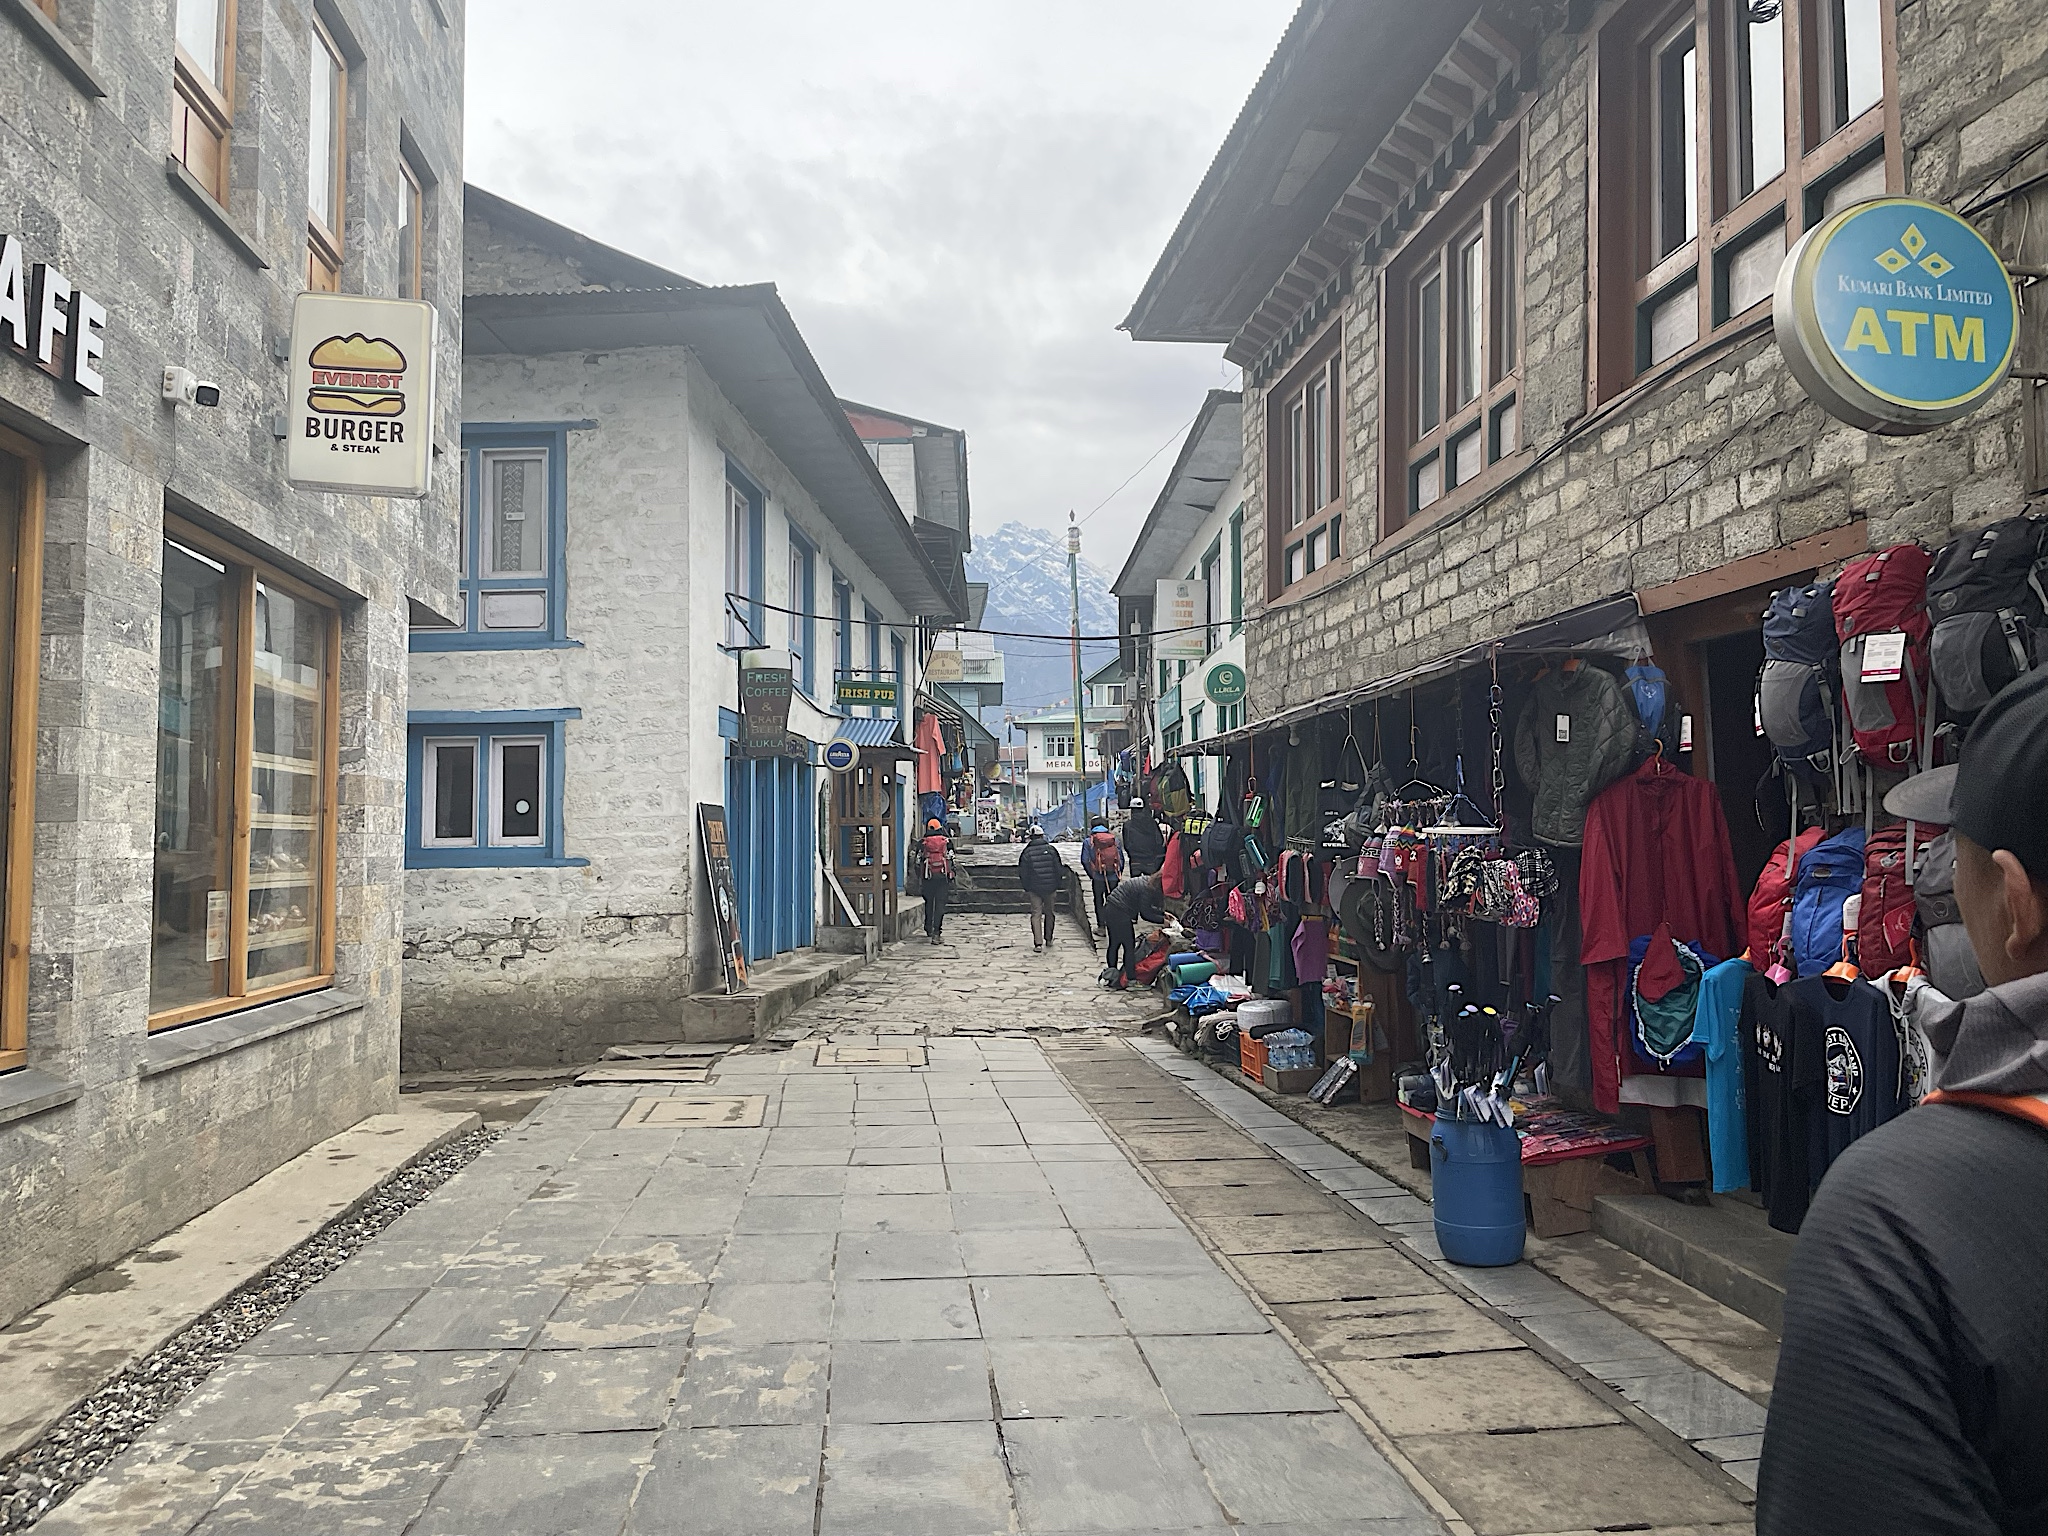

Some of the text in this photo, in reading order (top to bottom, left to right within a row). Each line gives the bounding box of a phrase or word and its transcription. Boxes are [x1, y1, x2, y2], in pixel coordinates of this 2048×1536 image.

[1838, 275, 1993, 306] KUMARI BANK LIMITED
[1844, 306, 1986, 363] ATM
[312, 370, 403, 389] EVEREST
[306, 417, 404, 443] BURGER
[342, 445, 380, 453] STEAK
[746, 672, 787, 683] FRESH
[745, 686, 788, 697] COFFEE
[840, 688, 895, 700] IRISH PUB
[1213, 686, 1241, 694] LUKLA
[762, 702, 772, 712] &
[749, 715, 784, 724] CRAFT
[750, 724, 783, 734] BEER
[749, 739, 784, 748] LUKLA
[1046, 760, 1073, 768] MERA
